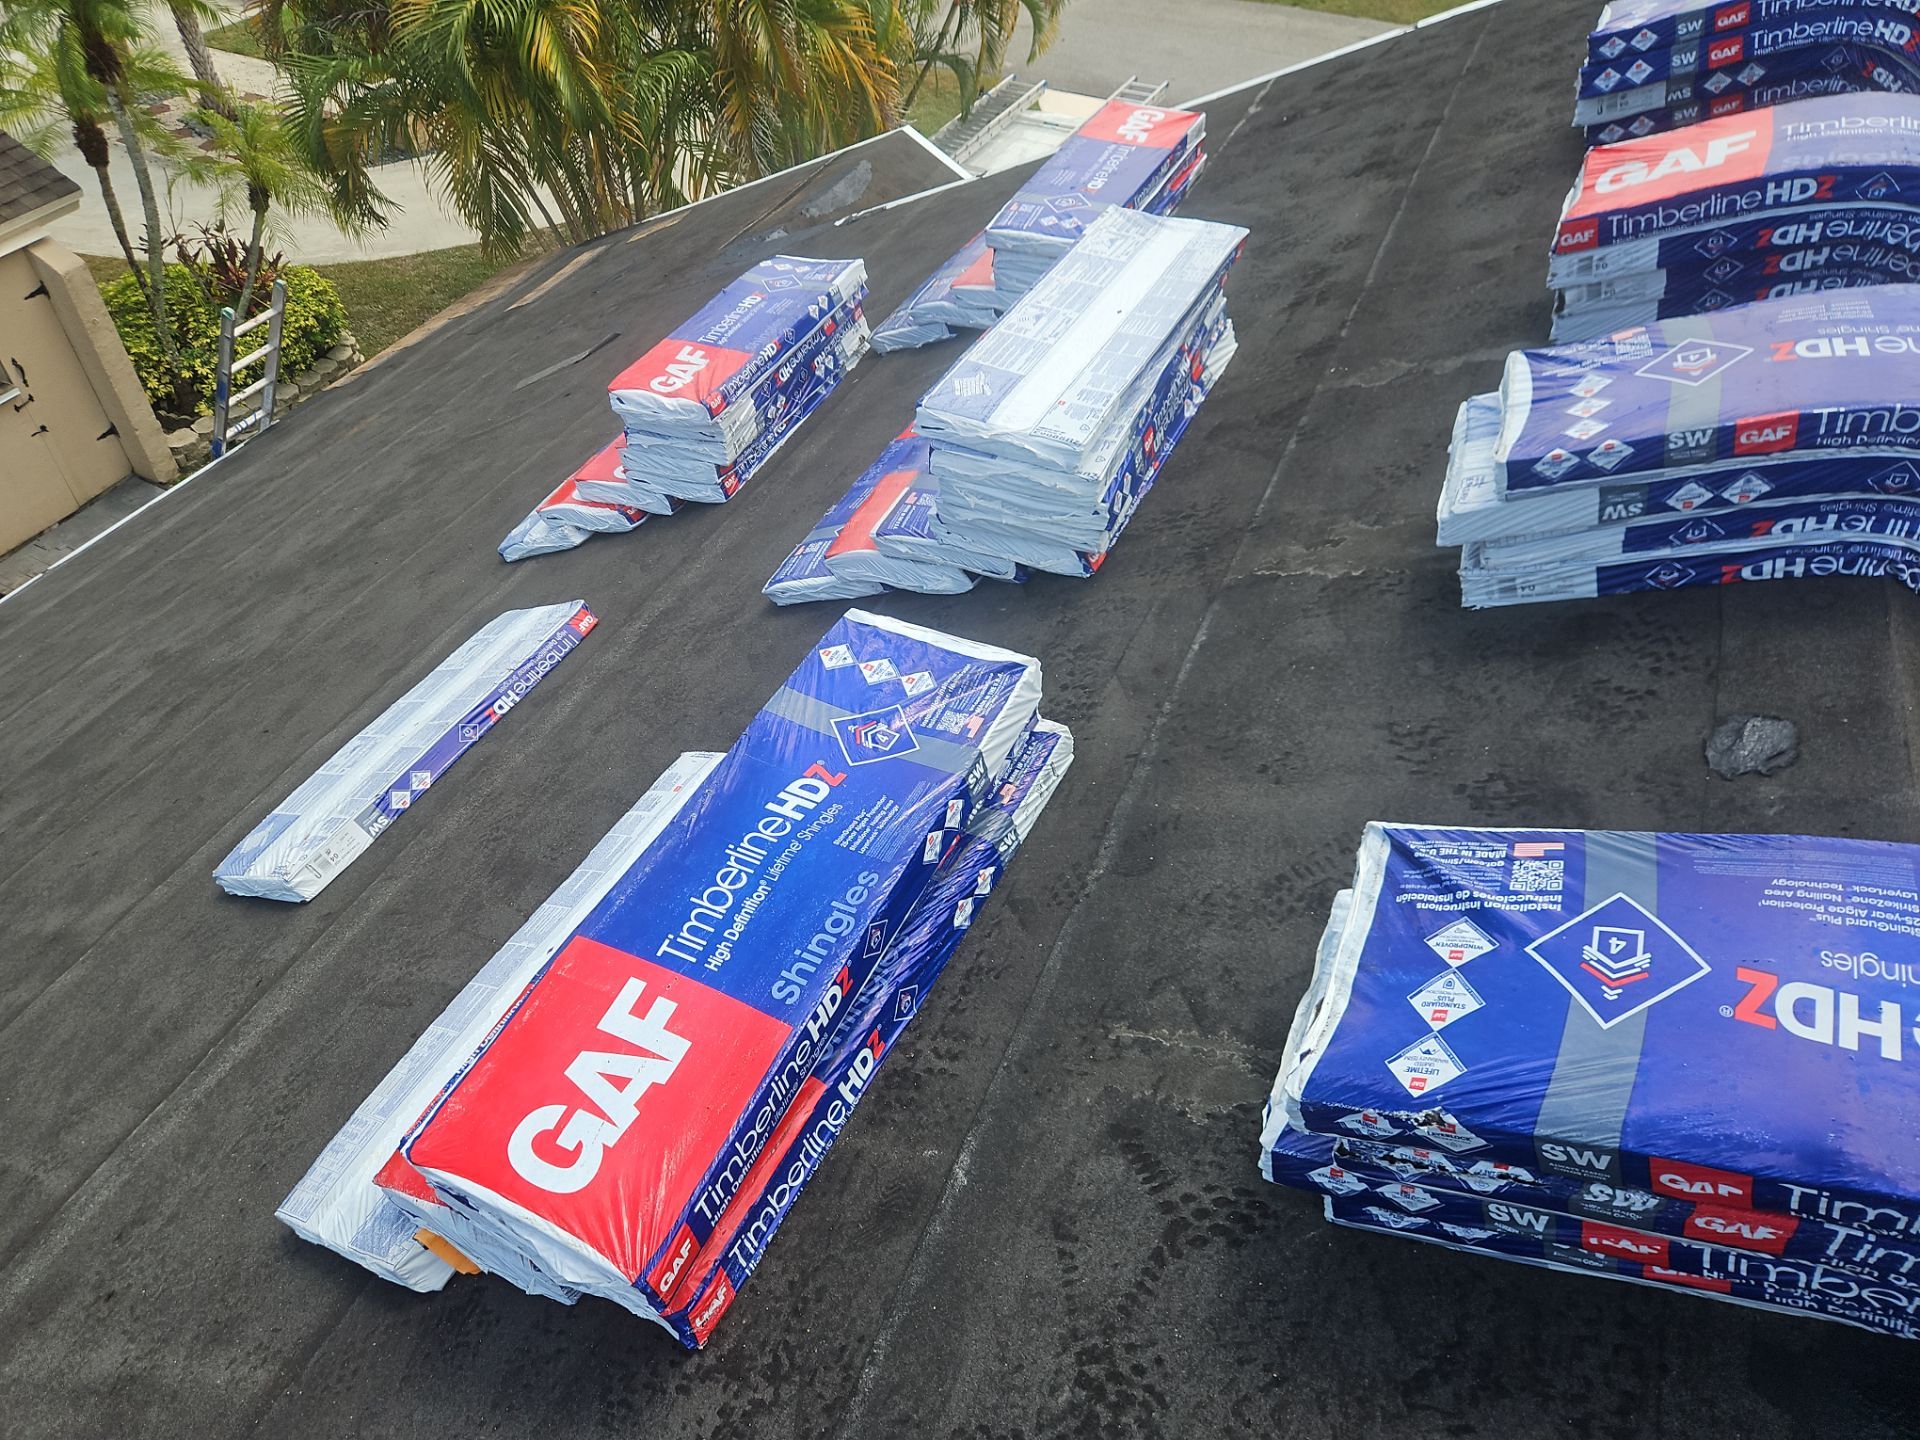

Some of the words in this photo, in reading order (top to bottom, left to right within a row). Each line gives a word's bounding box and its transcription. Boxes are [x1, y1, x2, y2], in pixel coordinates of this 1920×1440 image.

[1678, 19, 1703, 35] SW
[1717, 12, 1746, 28] GAF
[1671, 51, 1697, 67] SW
[1710, 44, 1741, 60] GAF
[1674, 106, 1698, 120] SW
[1713, 100, 1741, 115] GAF
[1116, 109, 1165, 143] GAF
[1594, 130, 1757, 194] GAF
[1560, 229, 1595, 248] GAF
[650, 346, 709, 394] GAF
[1667, 429, 1713, 450] SW
[1739, 424, 1793, 445] GAF
[1601, 502, 1644, 521] SW
[577, 614, 594, 633] GAF
[967, 756, 987, 797] SW
[367, 814, 392, 838] SW
[998, 828, 1020, 856] SW
[1439, 846, 1460, 857] THE
[1461, 847, 1474, 857] IN
[1475, 847, 1507, 858] MADE
[704, 940, 733, 973] High
[797, 803, 844, 842] Shingles
[1455, 890, 1469, 900] de
[1771, 878, 1844, 891] Technology
[1764, 888, 1794, 898] Area
[1796, 890, 1842, 903] Nailing
[1484, 901, 1562, 912] Installation
[1828, 905, 1868, 918] Algae
[1871, 909, 1920, 926] 25-year
[771, 870, 879, 1005] Shingles
[507, 976, 692, 1195] GAF
[1541, 1143, 1613, 1170] SW
[1582, 1183, 1661, 1211] SW
[1487, 1203, 1550, 1232] SW
[1694, 1216, 1785, 1240] GAF
[659, 1237, 692, 1293] GAF
